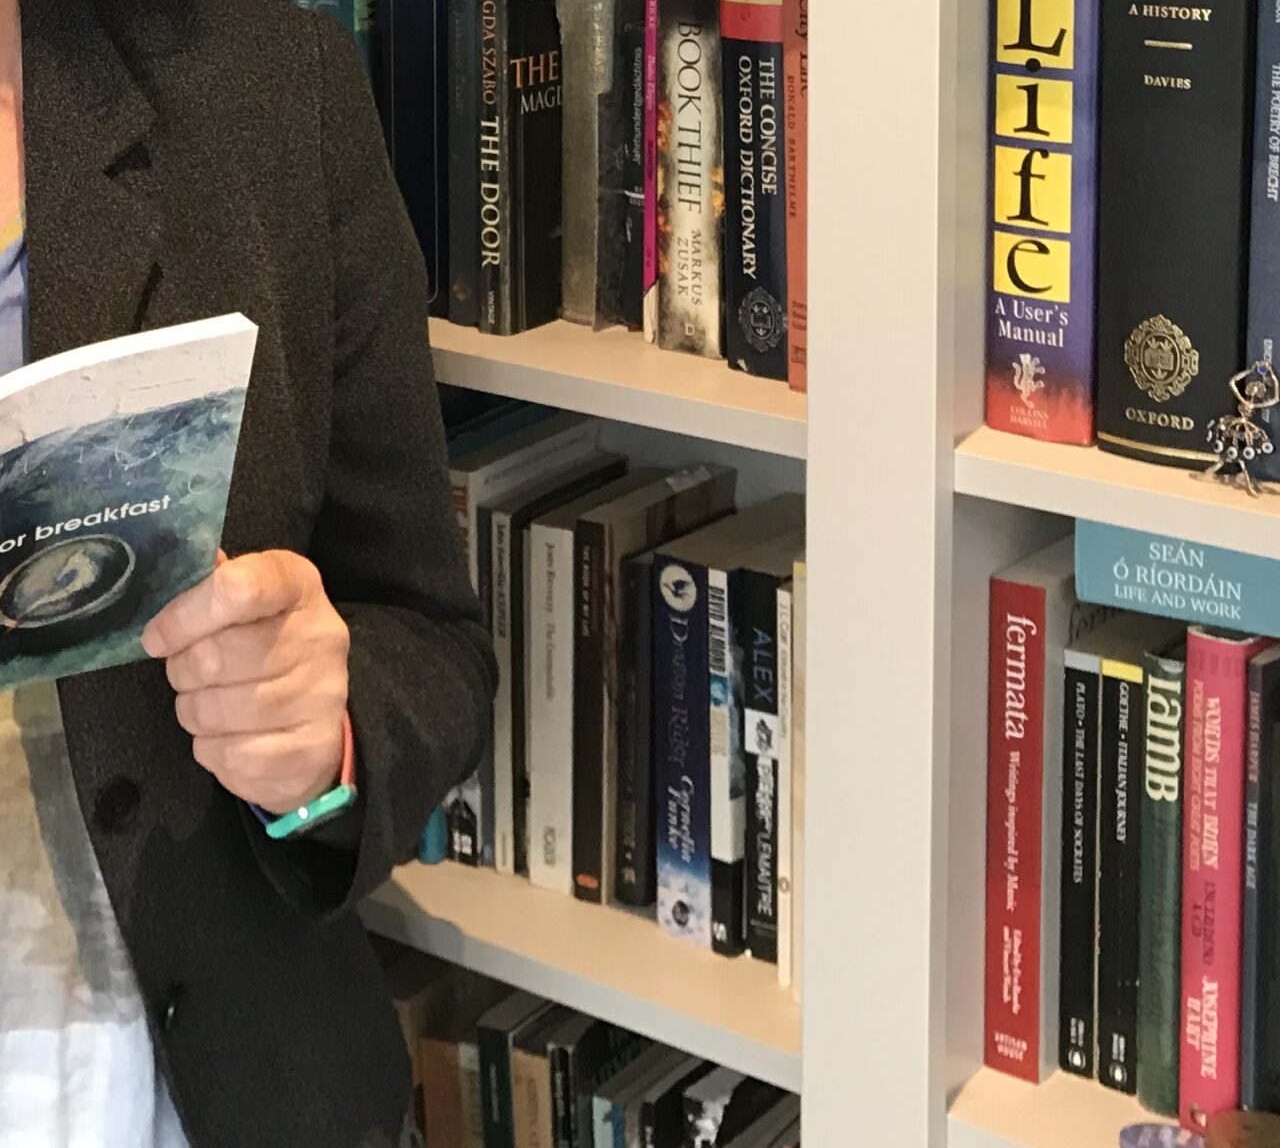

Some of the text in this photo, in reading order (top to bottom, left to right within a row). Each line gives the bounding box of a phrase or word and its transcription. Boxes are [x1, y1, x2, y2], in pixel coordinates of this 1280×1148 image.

[1128, 3, 1213, 23] A HISTORY
[481, 44, 496, 106] SZABO
[509, 50, 559, 90] THE
[1143, 74, 1192, 90] DAVIES
[480, 115, 500, 175] THE
[676, 21, 703, 215] BOOK THIEF
[759, 57, 777, 196] THE CONCISE
[739, 53, 758, 280] OXFORD DICTIONARY
[479, 181, 501, 268] DOOR
[676, 236, 689, 298] ZUSAK
[690, 228, 702, 308] MARKUS
[994, 298, 1069, 327] A User's
[997, 318, 1065, 348] Manual
[1124, 406, 1196, 431] OXFORD
[33, 493, 173, 543] breakfast
[1112, 555, 1243, 602] Ó RÍORDÁIN
[1147, 540, 1205, 569] SEÁN
[1113, 584, 1243, 621] LIFE AND WORK
[753, 626, 774, 704] ALEX
[1202, 695, 1221, 870] WORDS THAT BURN
[1185, 996, 1202, 1051] HART
[1200, 975, 1219, 1081] JOSEPHINE
